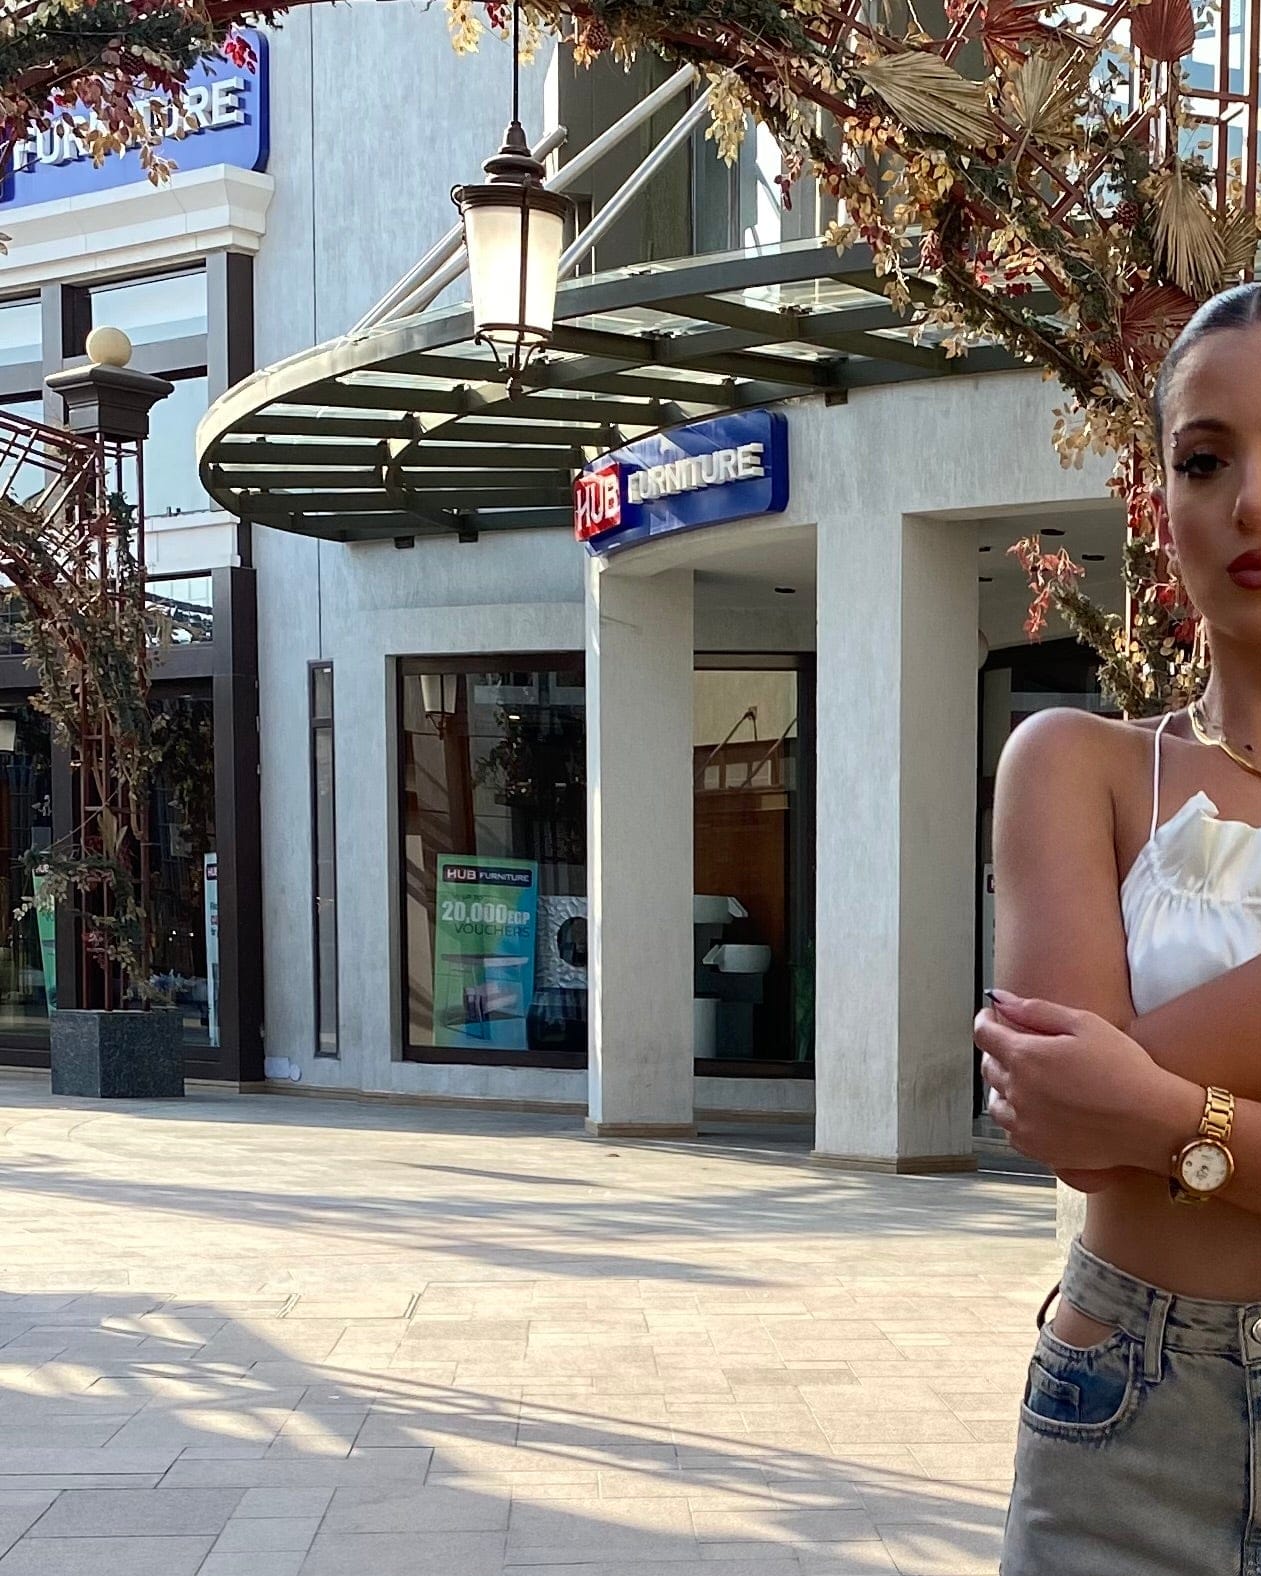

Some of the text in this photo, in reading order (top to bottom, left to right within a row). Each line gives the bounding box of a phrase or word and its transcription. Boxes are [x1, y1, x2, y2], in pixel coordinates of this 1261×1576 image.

[13, 76, 245, 171] FURTURE
[576, 442, 765, 531] HUB FURNITURE
[447, 869, 530, 882] HUB FURNITURE
[455, 923, 530, 938] VOUCHERS
